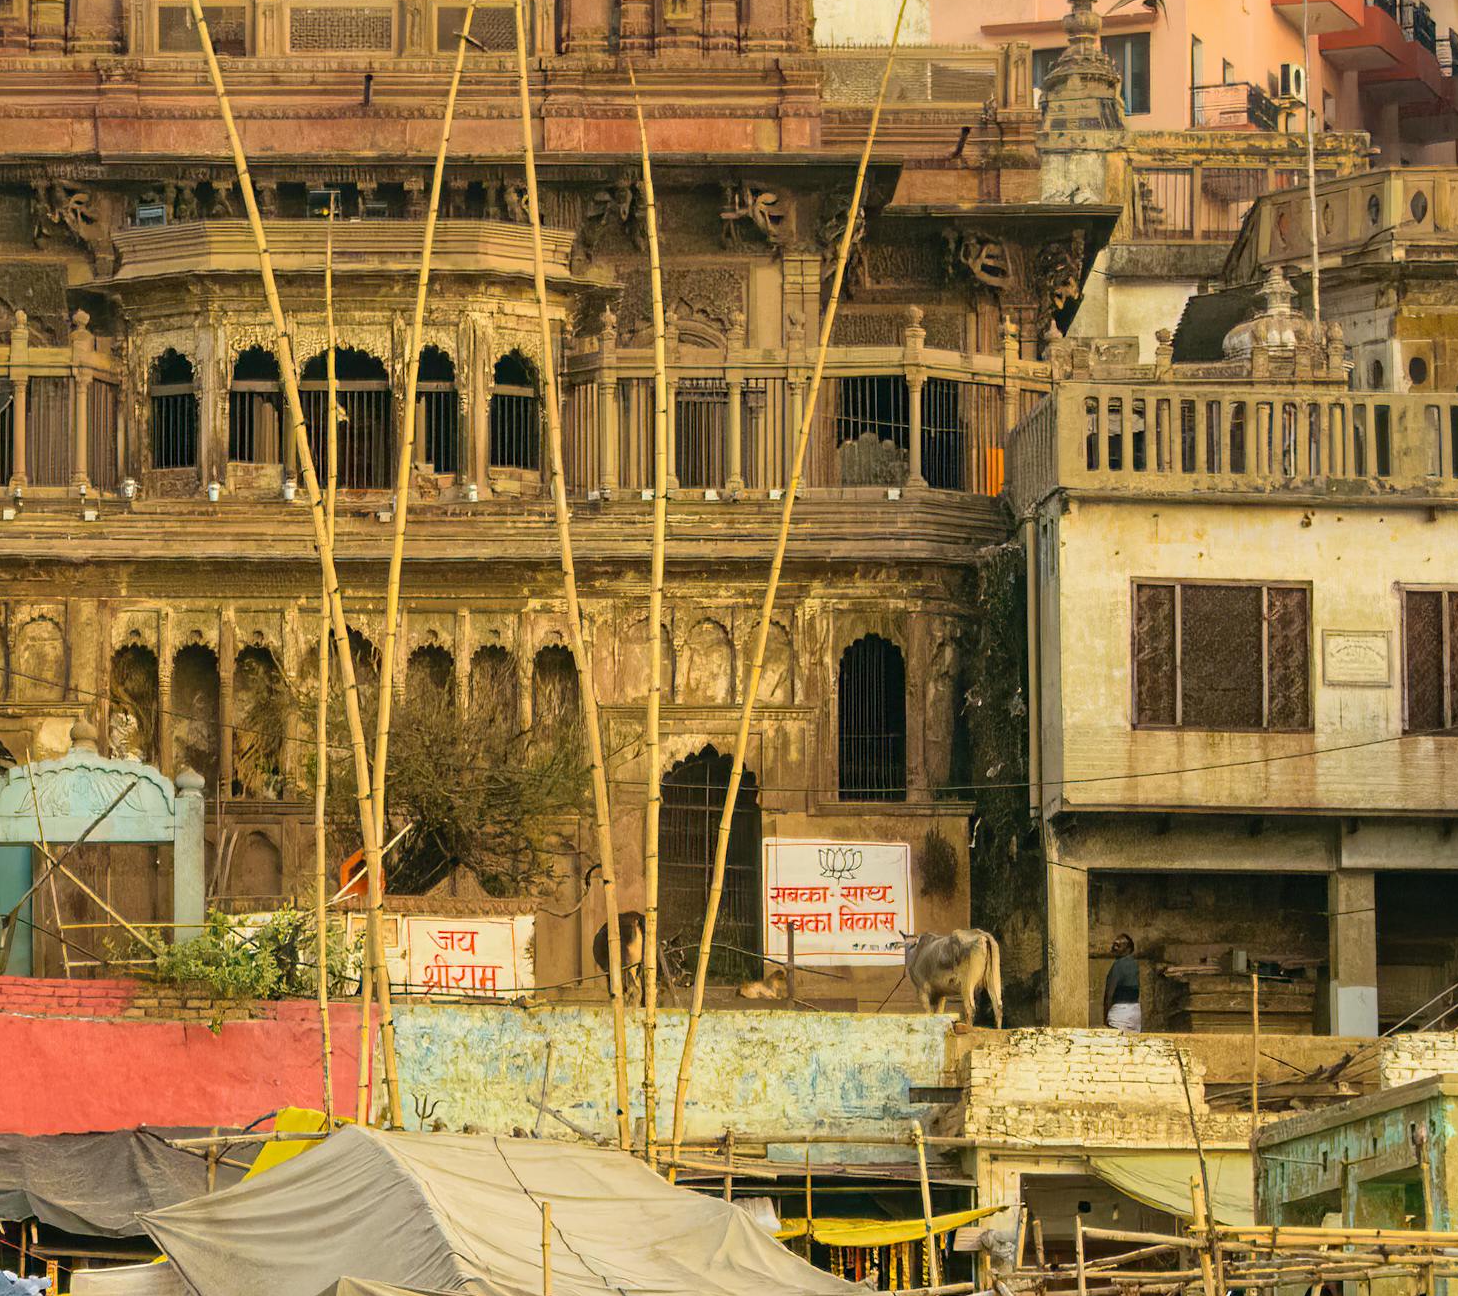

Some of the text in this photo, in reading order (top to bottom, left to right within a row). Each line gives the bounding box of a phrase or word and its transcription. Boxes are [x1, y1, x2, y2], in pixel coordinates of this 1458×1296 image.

[770, 905, 895, 933] सबका विकास
[427, 931, 478, 955] जय
